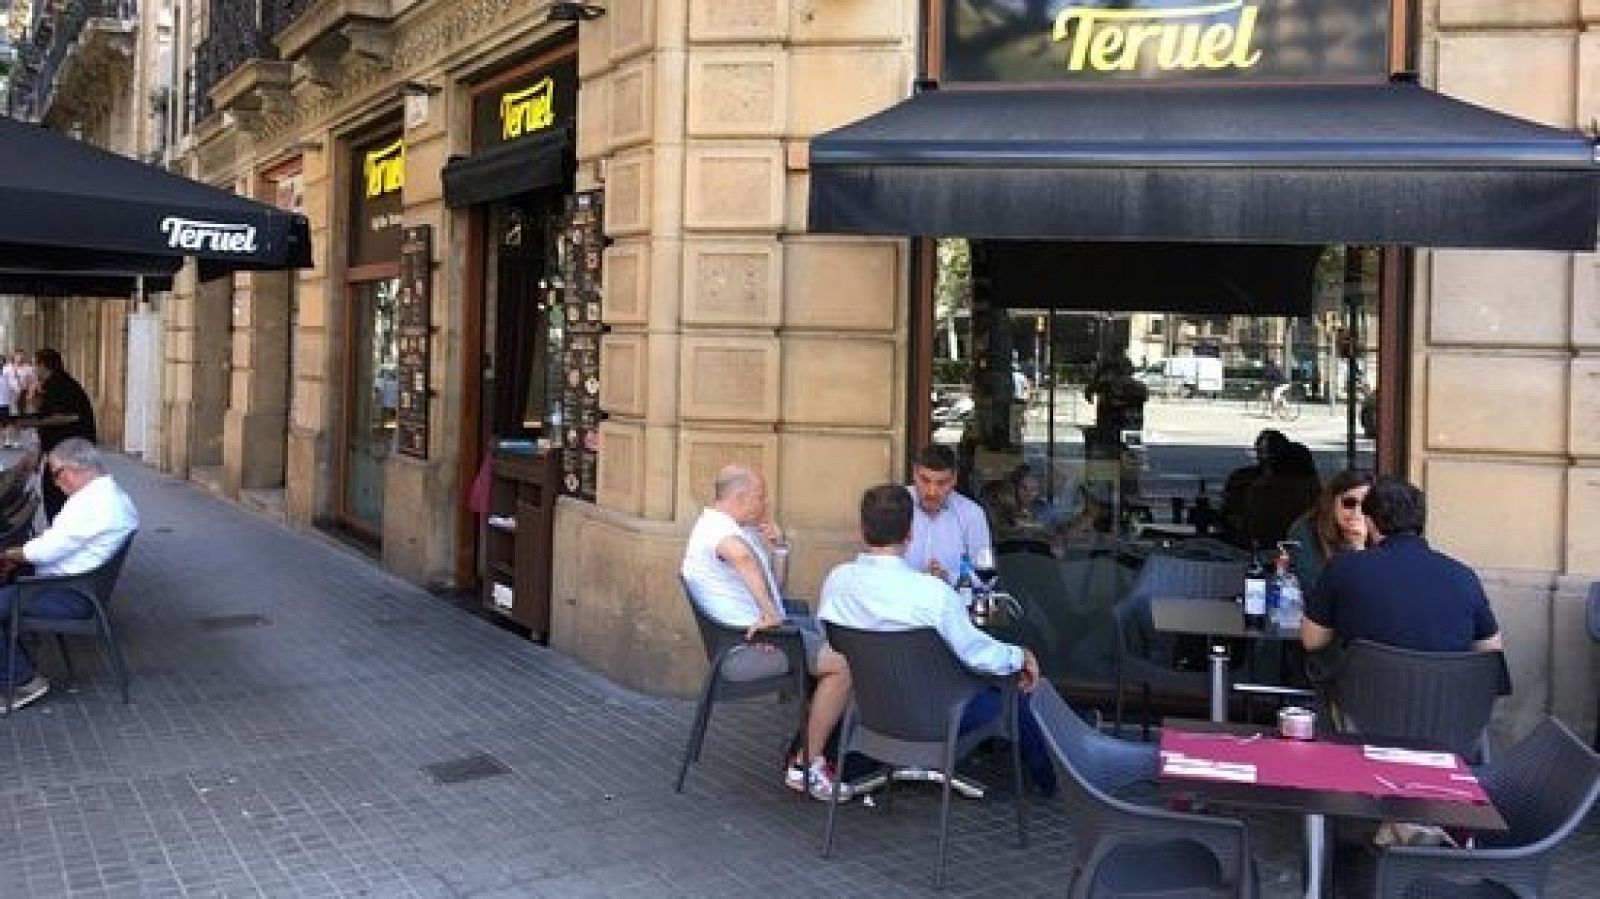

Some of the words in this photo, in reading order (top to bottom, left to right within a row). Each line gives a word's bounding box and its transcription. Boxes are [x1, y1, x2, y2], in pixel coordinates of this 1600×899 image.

[1052, 0, 1262, 72] Teruel
[500, 76, 556, 140] Teruel
[161, 217, 257, 253] Teruel
